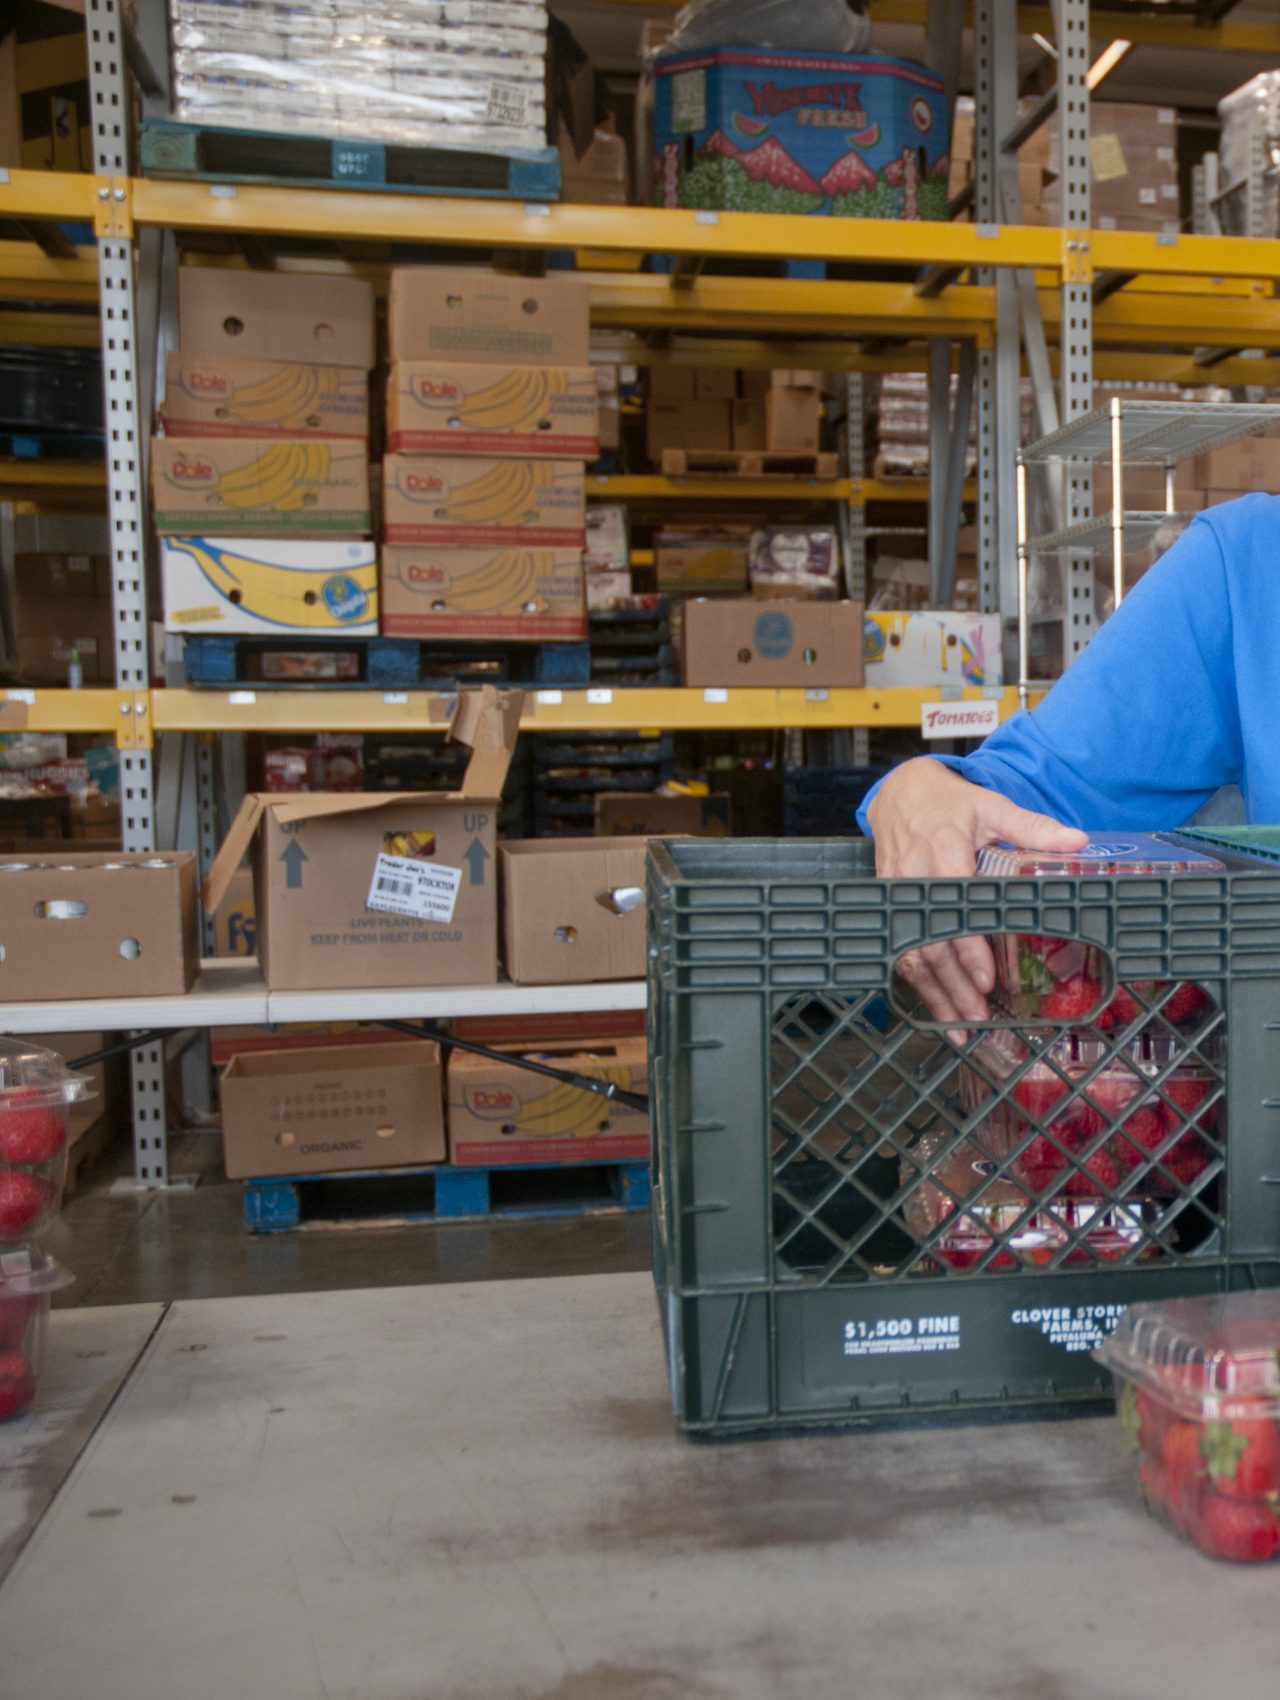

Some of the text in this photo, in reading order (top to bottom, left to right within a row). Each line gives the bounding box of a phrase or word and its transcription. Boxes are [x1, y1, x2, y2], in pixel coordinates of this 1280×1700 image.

[420, 380, 457, 398] Dole
[172, 462, 213, 480] Dole
[406, 474, 443, 492] Dole
[407, 565, 445, 583] Dole
[926, 709, 994, 728] TOMATOES
[463, 813, 489, 833] UP
[310, 930, 463, 946] KEEP FROM HEAT OR COLD
[474, 1090, 512, 1109] Dole
[300, 1140, 362, 1155] ORGANIC
[1011, 1307, 1071, 1323] CLOVER
[845, 1316, 960, 1340] $1,500 FINE
[1042, 1319, 1099, 1334] FARMS,
